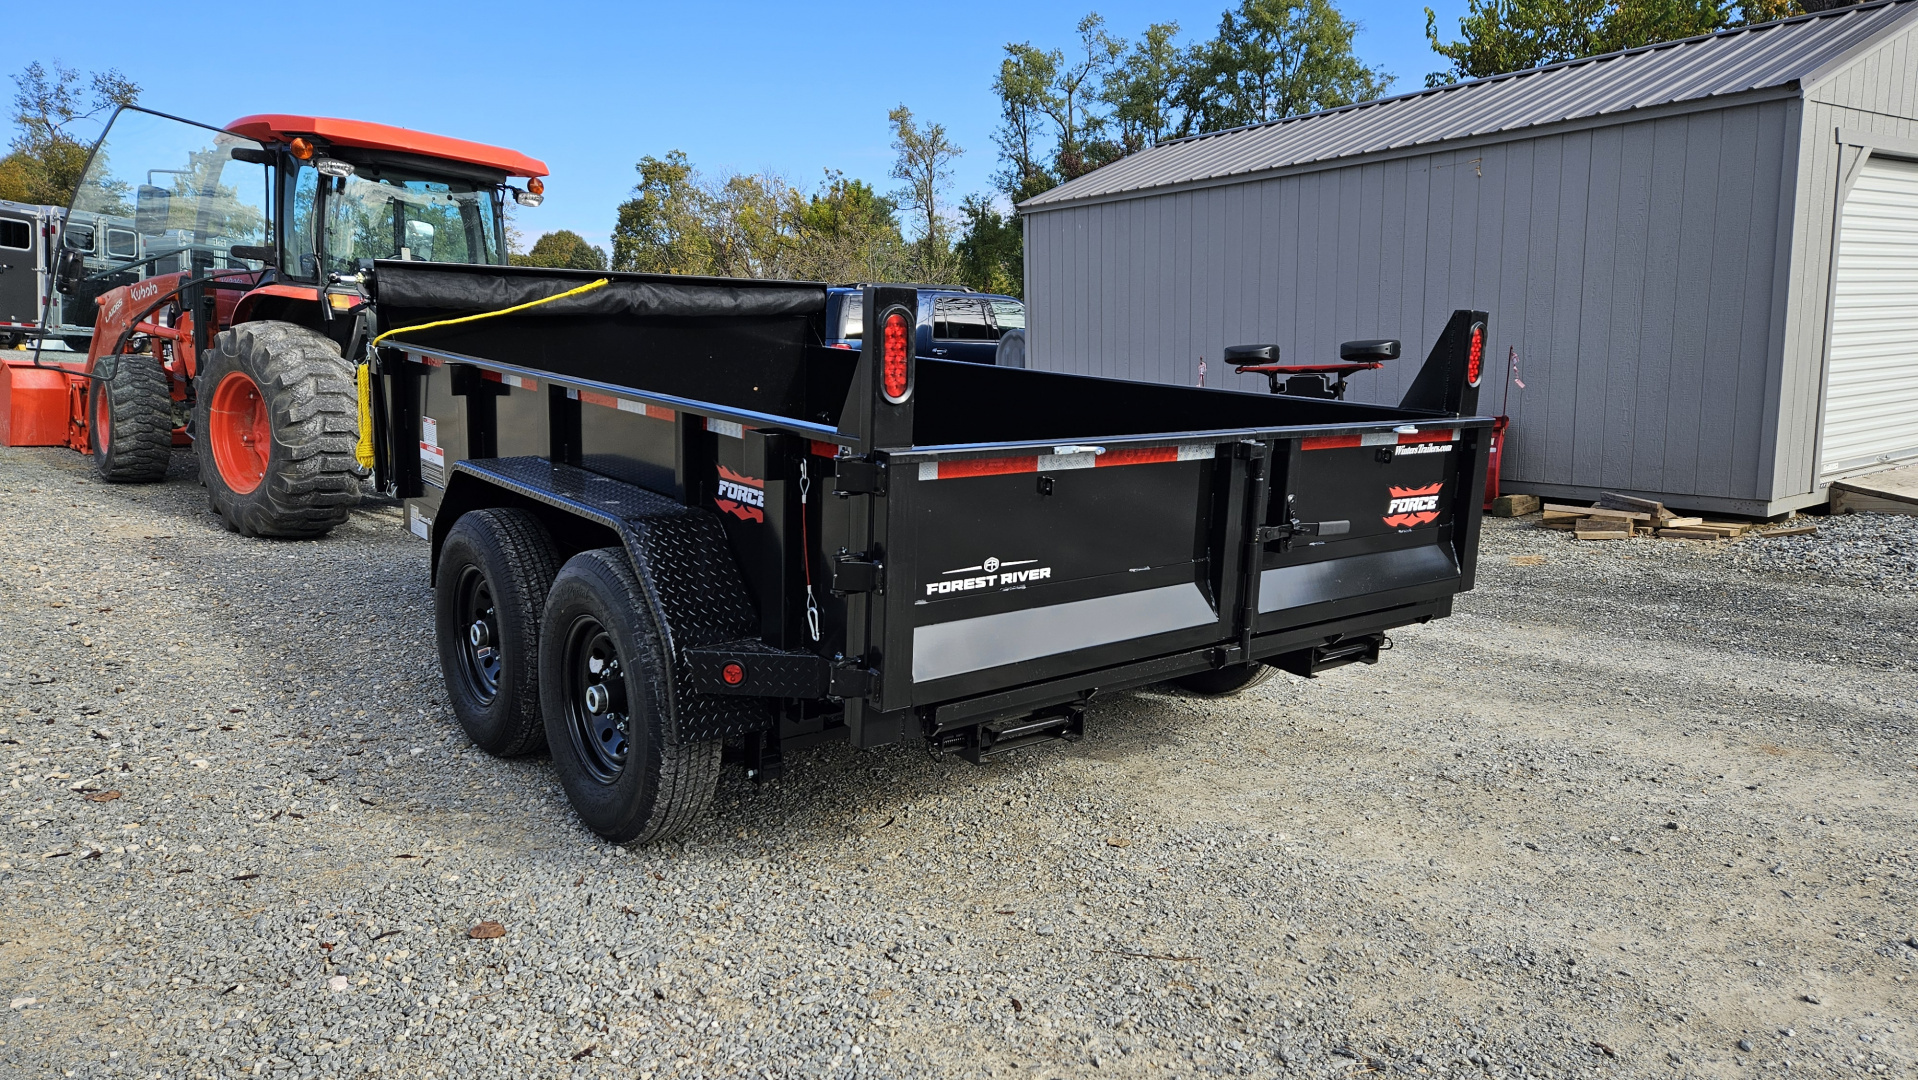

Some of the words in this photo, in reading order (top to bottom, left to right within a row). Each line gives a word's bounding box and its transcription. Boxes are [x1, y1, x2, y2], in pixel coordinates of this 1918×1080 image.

[130, 281, 158, 301] Kubota
[1394, 443, 1453, 456] WintersTrailers.com
[718, 480, 764, 507] FORCE
[1388, 495, 1439, 514] FORCE
[926, 575, 998, 595] FOREST
[1000, 567, 1051, 585] RIVER
